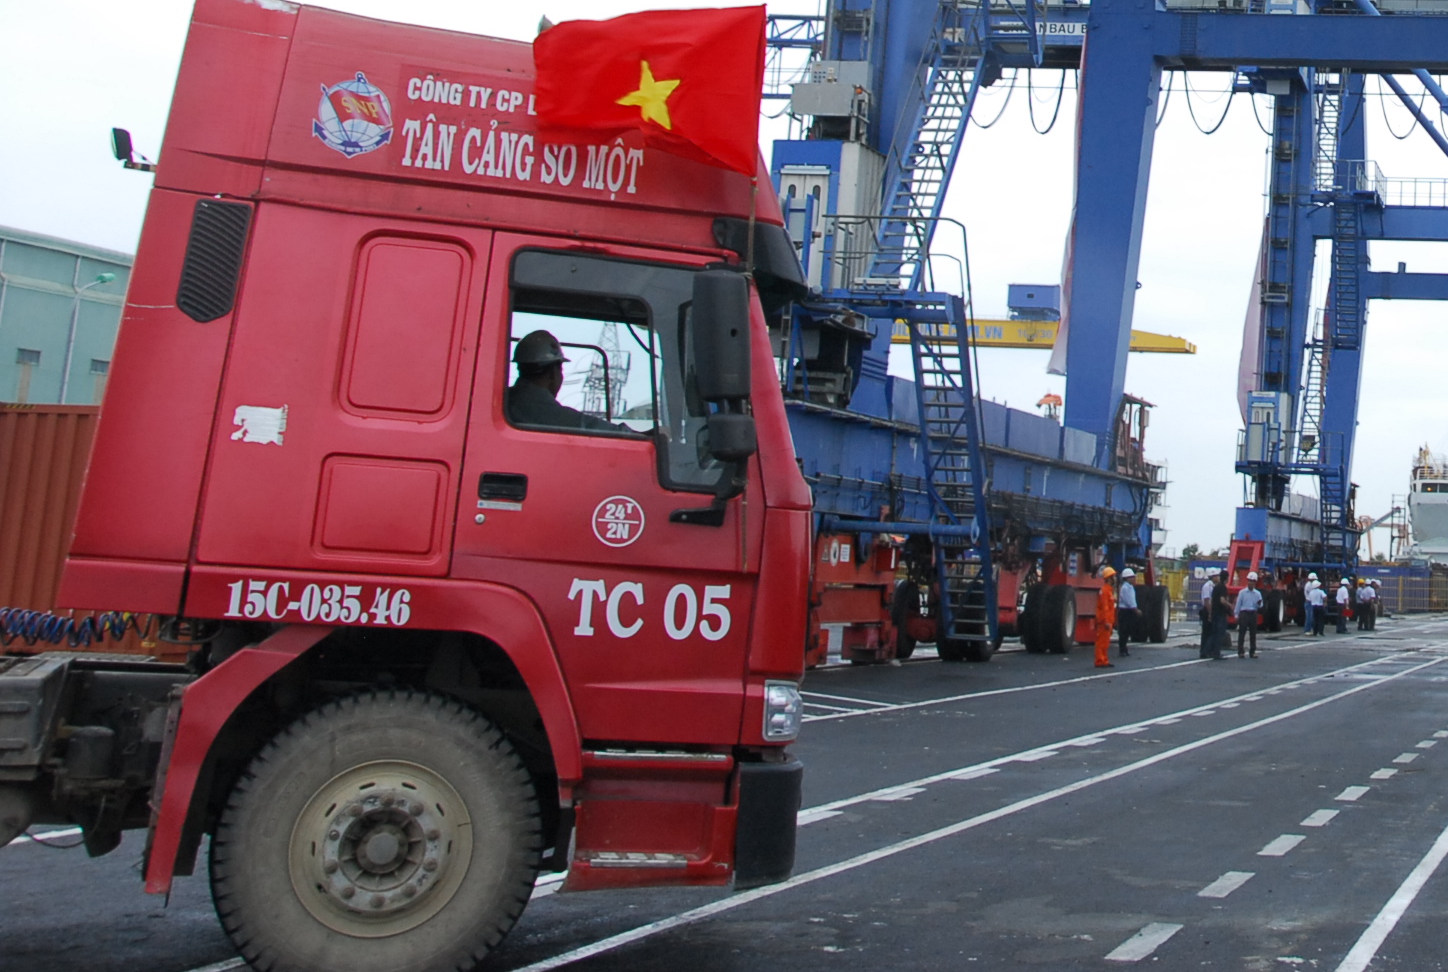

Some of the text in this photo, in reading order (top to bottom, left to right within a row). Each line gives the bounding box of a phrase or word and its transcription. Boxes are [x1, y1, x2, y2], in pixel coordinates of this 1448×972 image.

[341, 96, 378, 118] SNP
[407, 74, 462, 106] CÔNG
[468, 85, 493, 109] TY
[496, 89, 523, 114] CP
[402, 113, 458, 171] TÂN
[461, 119, 535, 182] CẢNG
[582, 138, 644, 201] MỘT
[606, 522, 630, 539] 2N
[223, 579, 412, 625] 15C-035.46
[567, 578, 731, 641] TC 05
